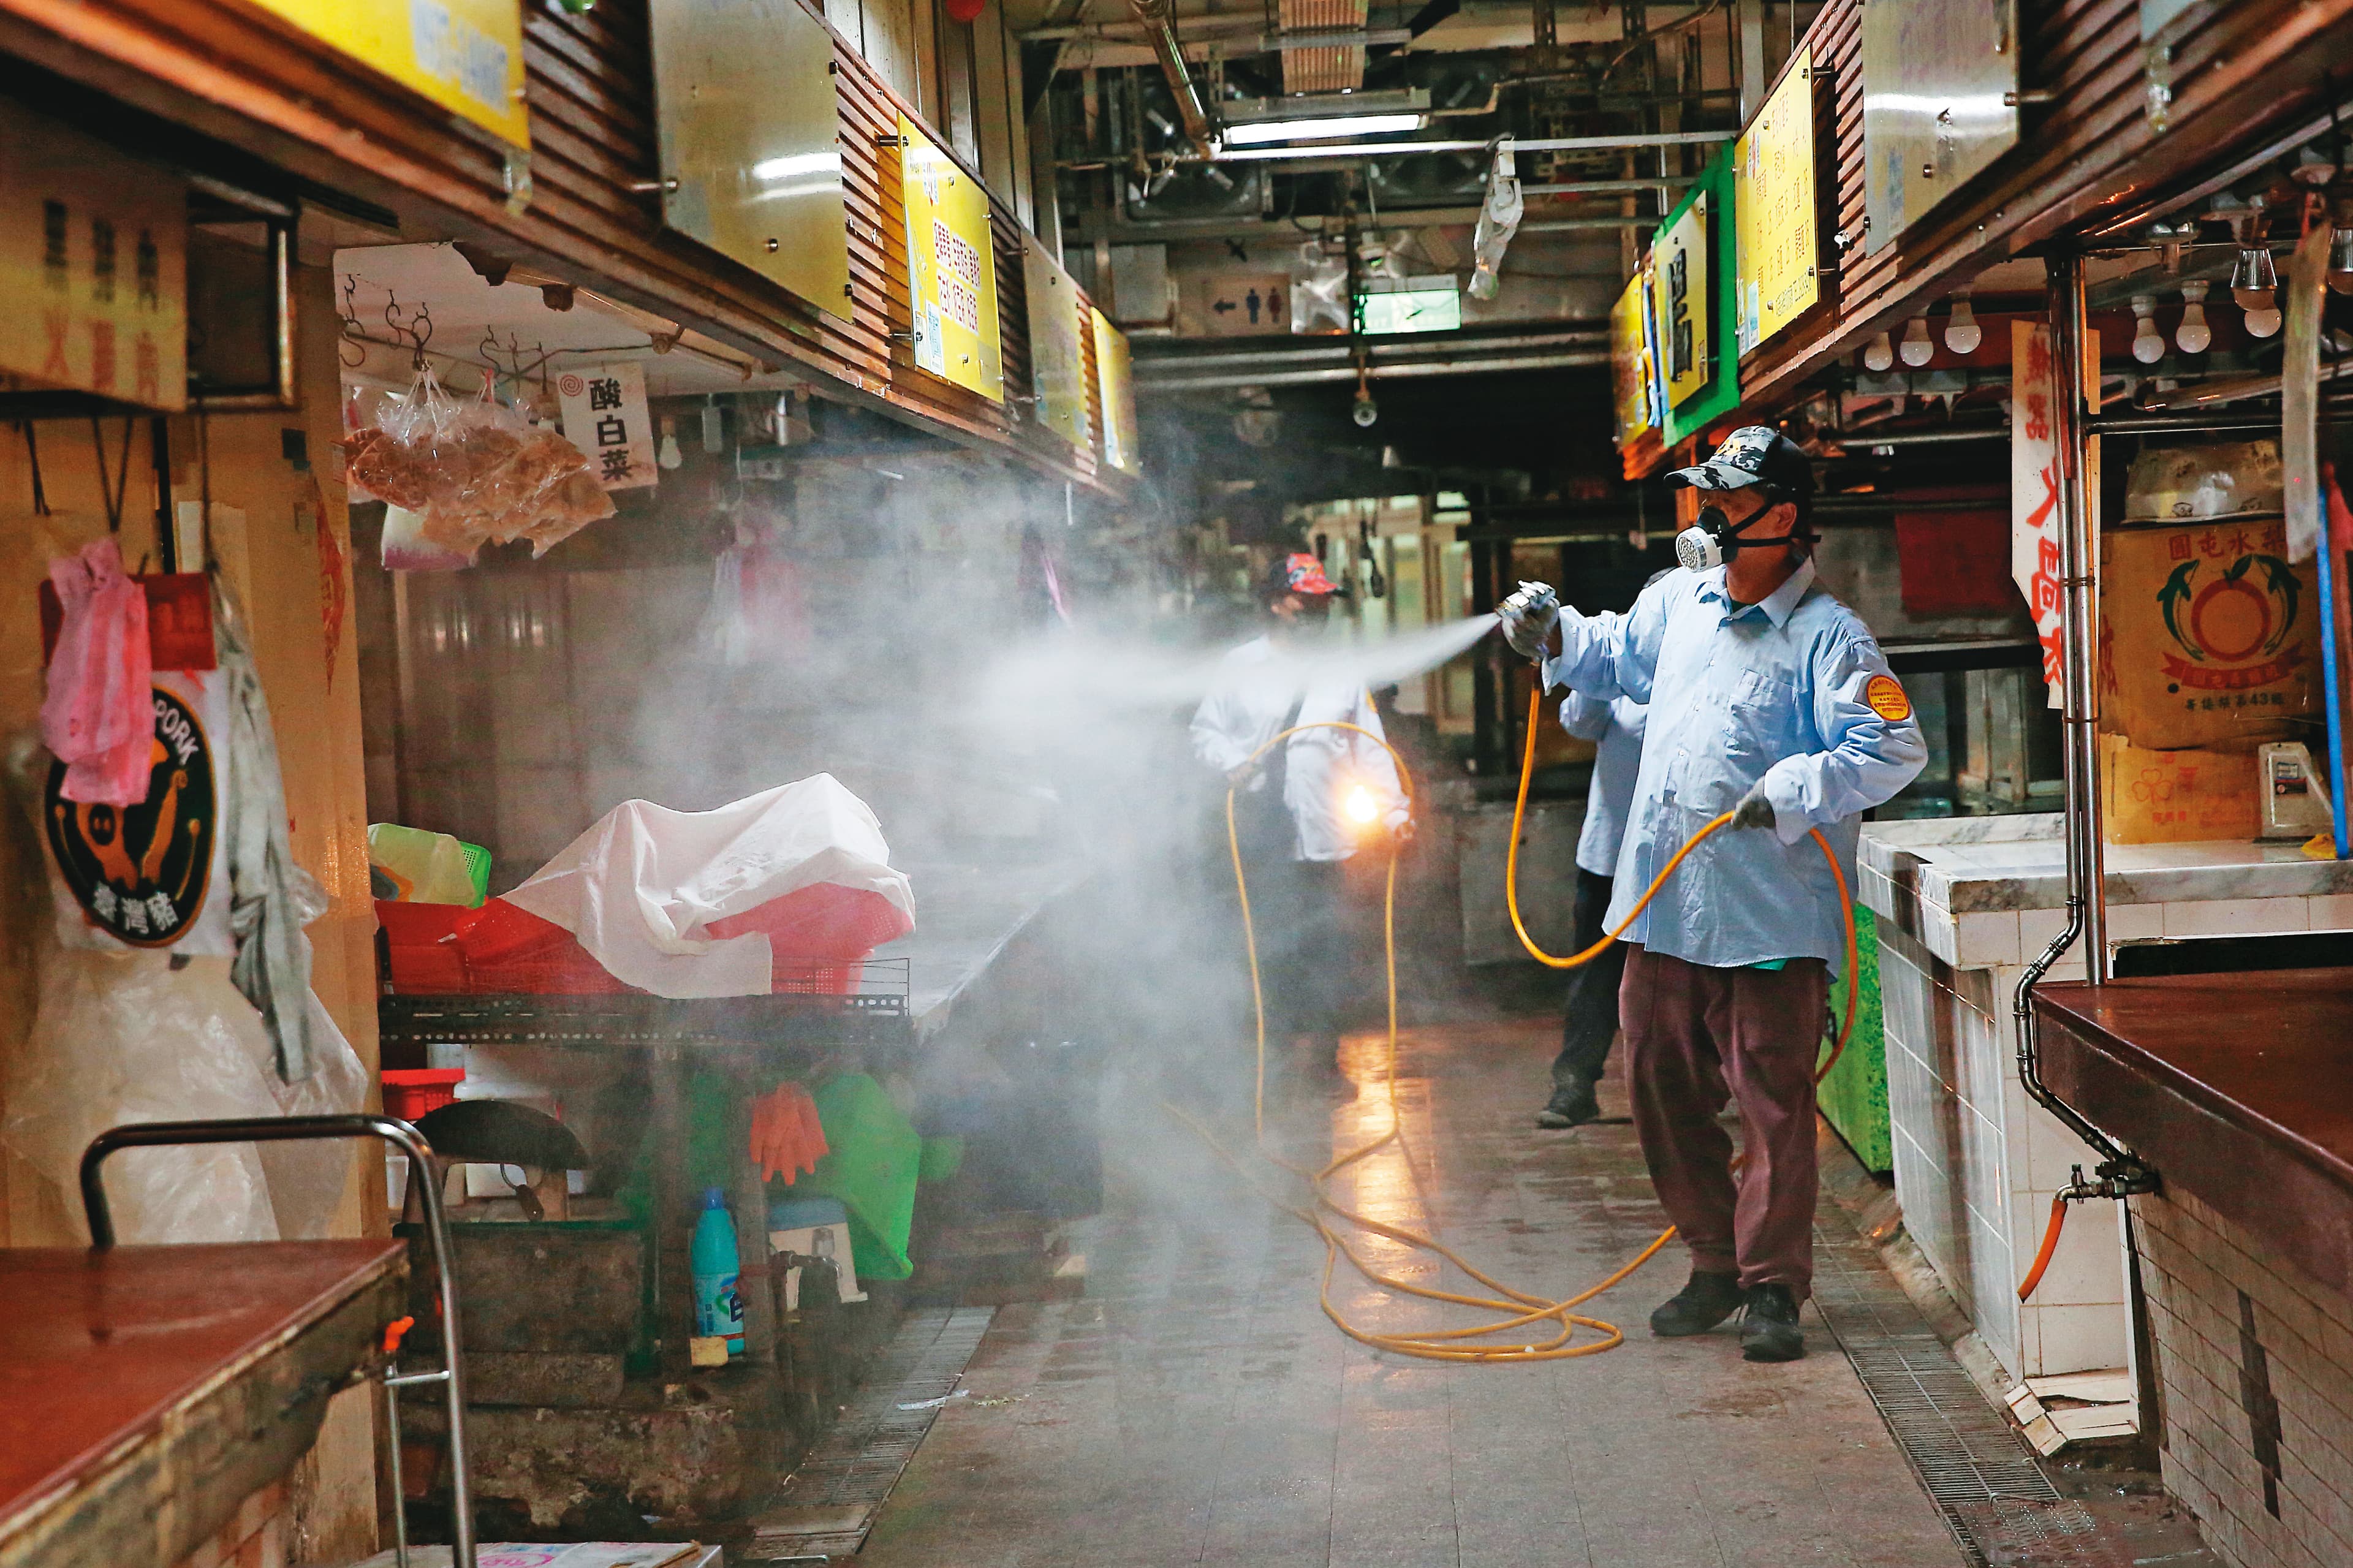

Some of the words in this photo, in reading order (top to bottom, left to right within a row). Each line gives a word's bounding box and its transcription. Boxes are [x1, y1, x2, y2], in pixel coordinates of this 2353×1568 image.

[589, 377, 632, 482] 酸白菜
[153, 699, 199, 765] PORK
